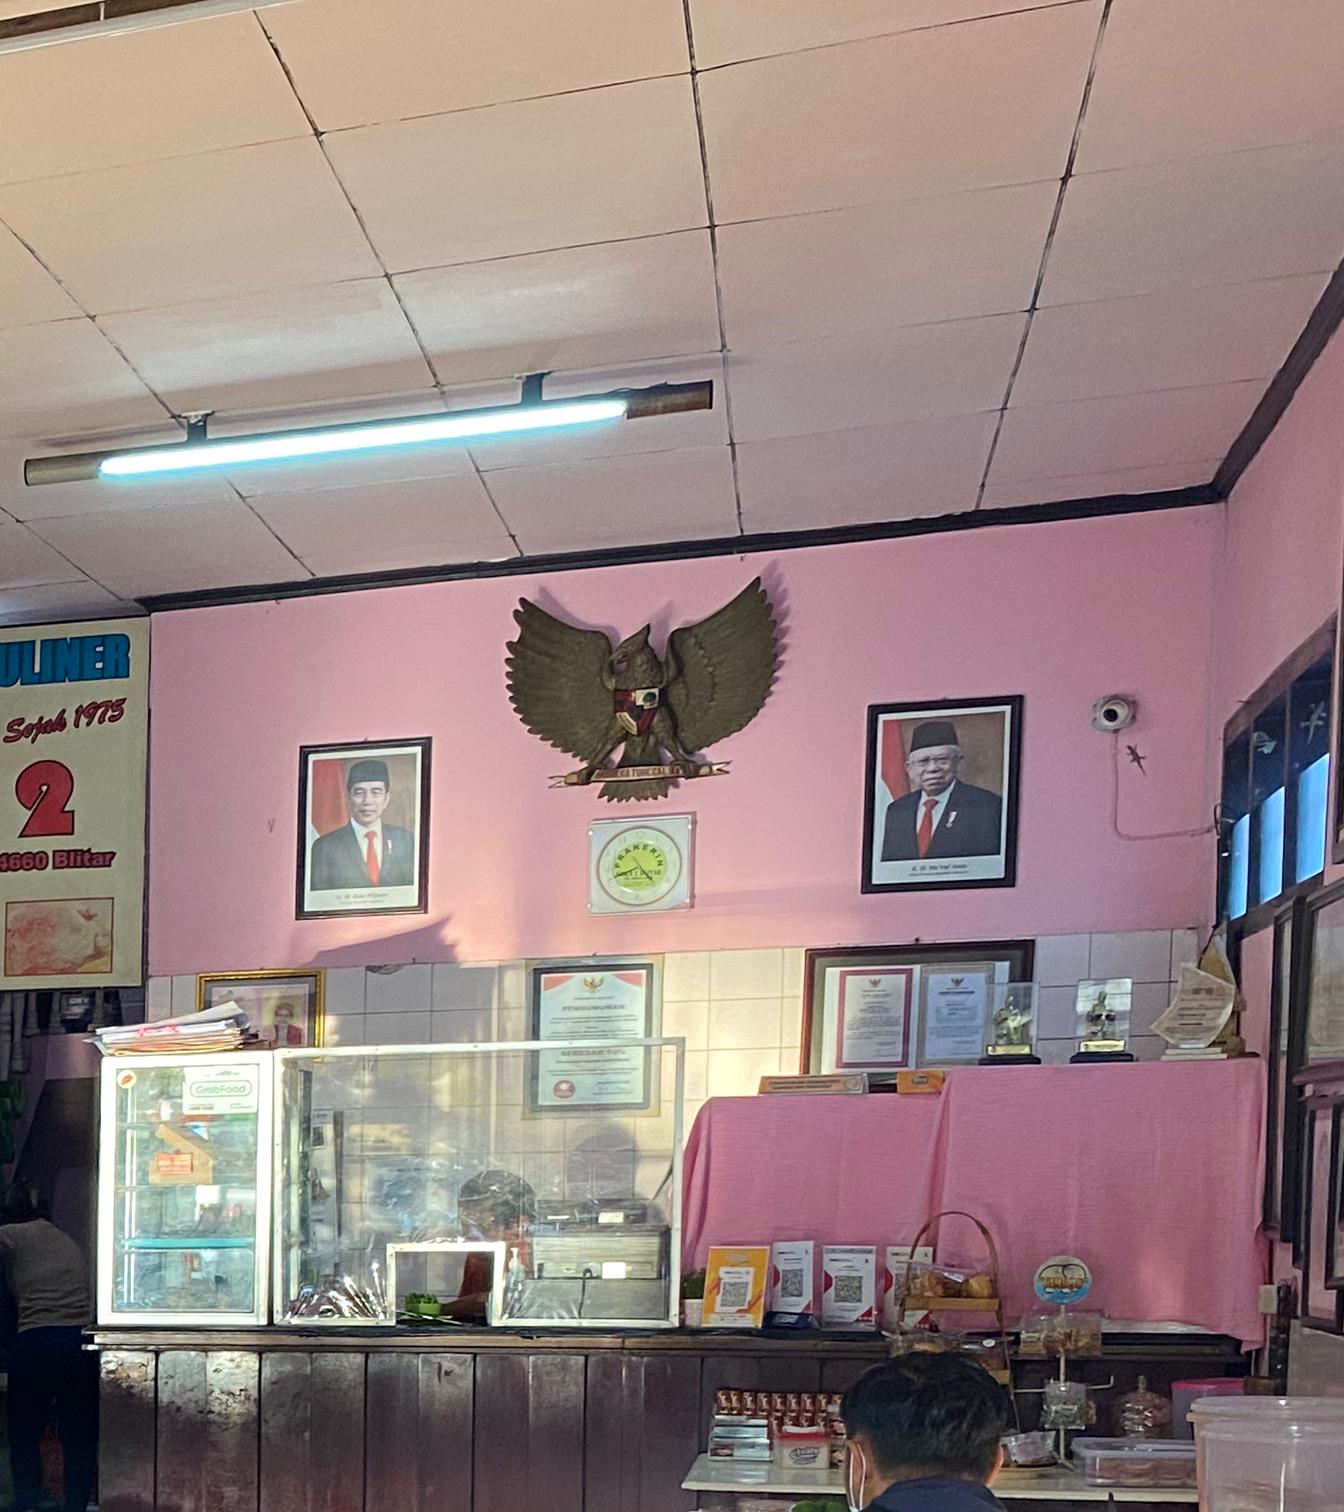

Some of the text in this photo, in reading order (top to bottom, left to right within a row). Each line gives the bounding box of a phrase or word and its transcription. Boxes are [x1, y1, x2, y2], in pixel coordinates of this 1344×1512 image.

[72, 697, 127, 729] 1975
[14, 759, 75, 839] 2
[52, 848, 117, 870] Blitar
